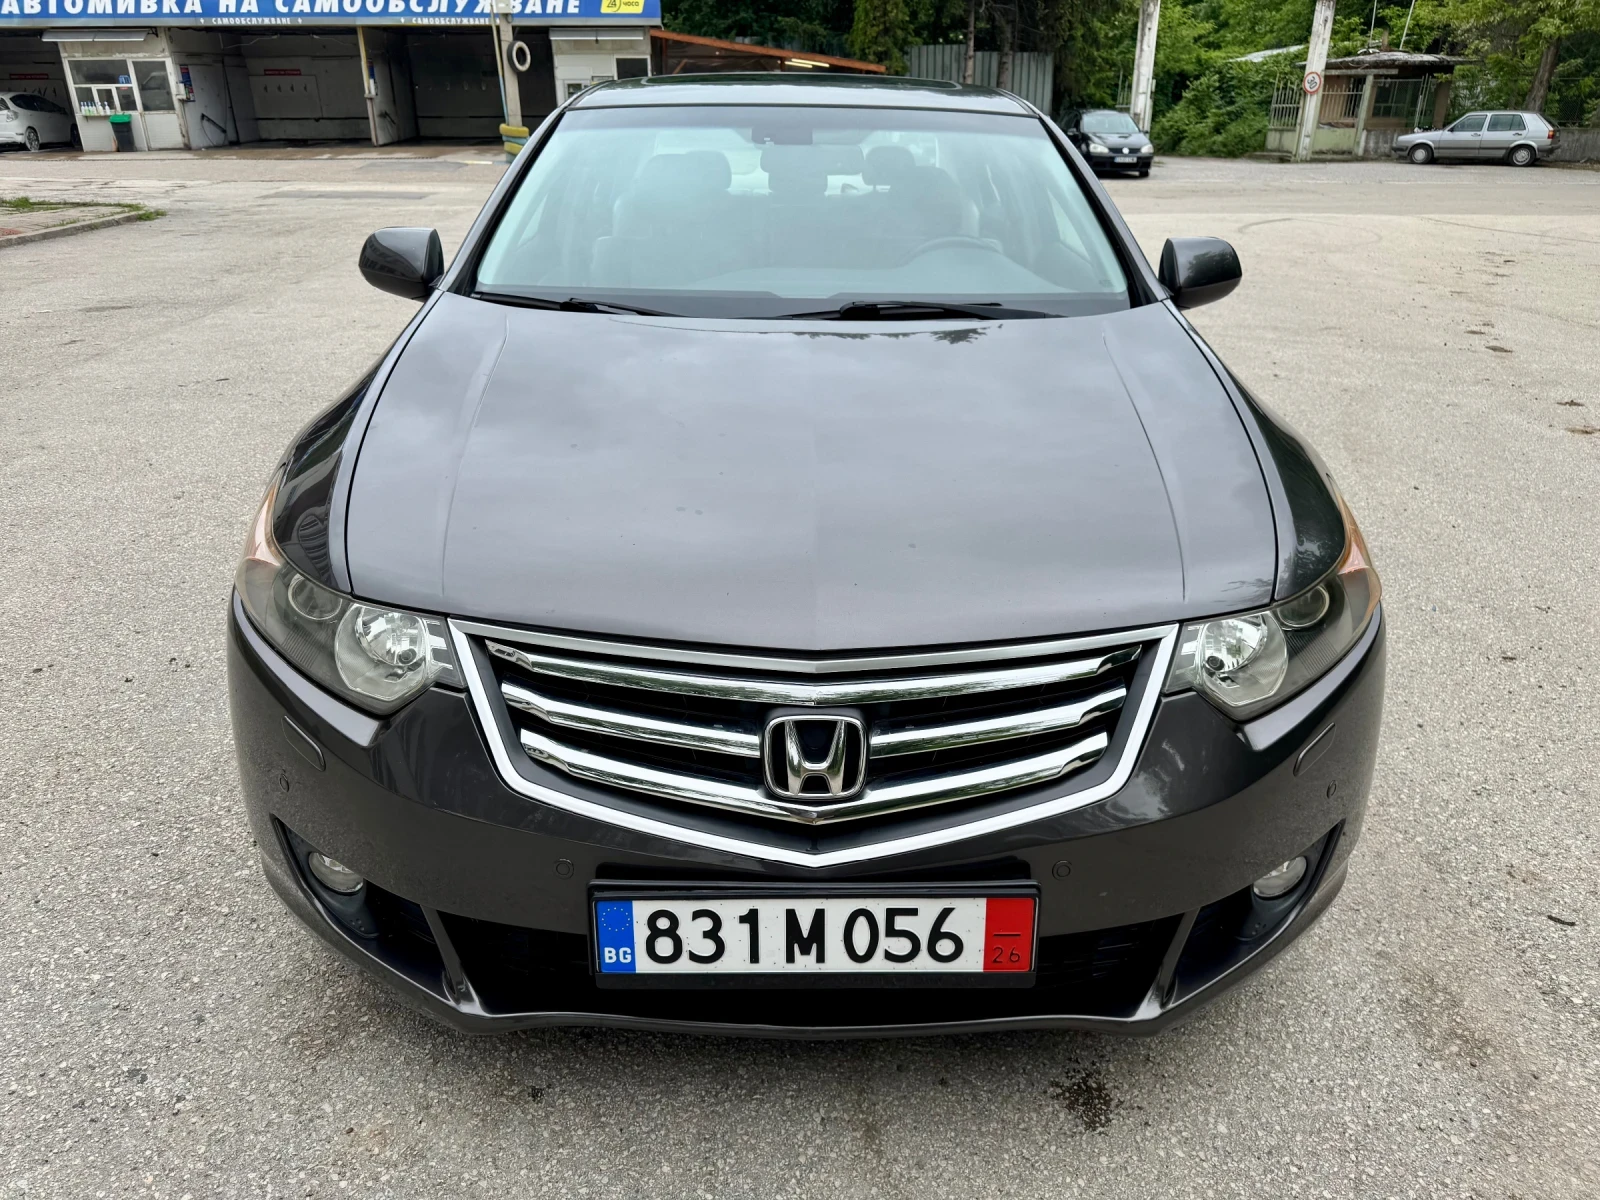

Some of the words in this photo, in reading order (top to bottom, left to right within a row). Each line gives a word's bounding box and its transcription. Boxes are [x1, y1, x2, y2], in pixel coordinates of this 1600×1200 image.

[1, 0, 202, 15] АВТОМИВКА
[218, 0, 259, 14] НА
[211, 17, 291, 25] САМООБСЛУЖВАНЕ
[412, 17, 490, 25] САМООБСЛУЖВАНЕ
[1307, 76, 1317, 89] 30
[645, 907, 761, 965] 831
[842, 907, 964, 964] 056
[604, 947, 633, 964] BG
[992, 946, 1021, 964] 26
